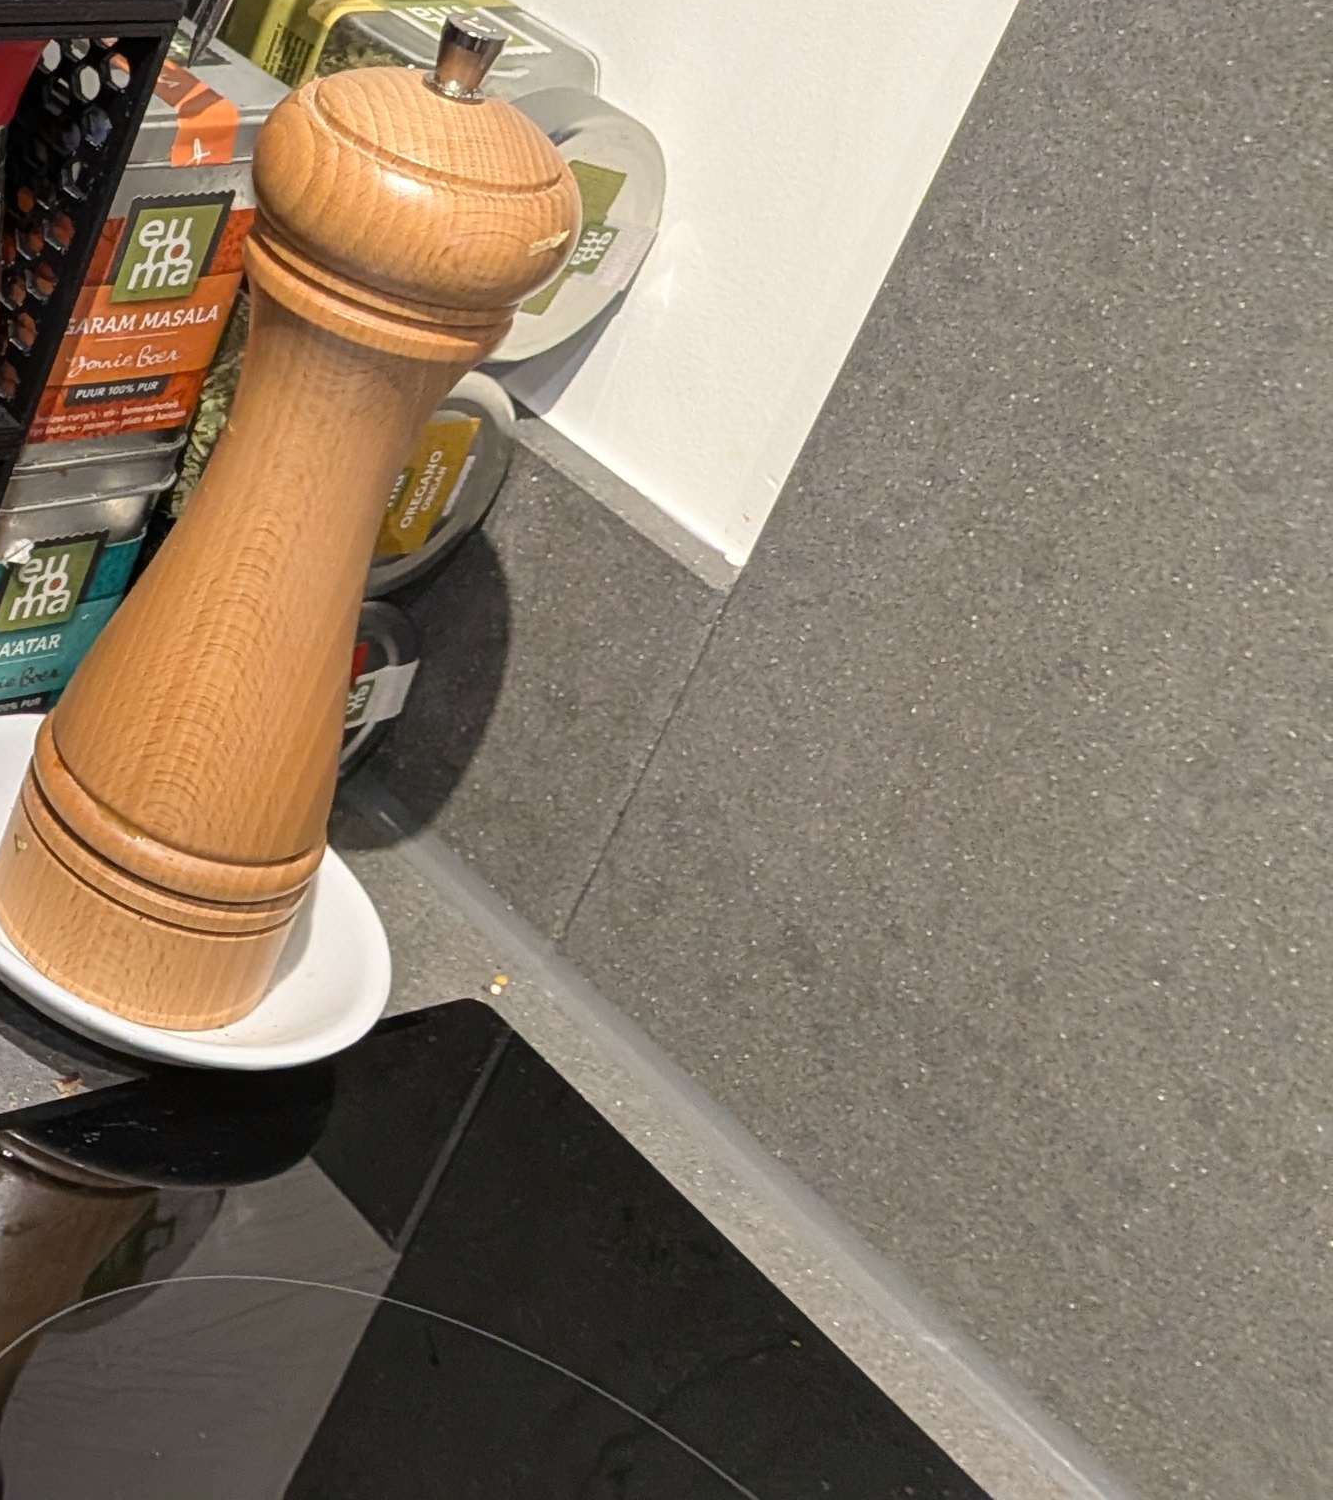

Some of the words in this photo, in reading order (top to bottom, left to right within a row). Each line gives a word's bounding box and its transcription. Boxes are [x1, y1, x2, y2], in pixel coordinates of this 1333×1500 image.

[64, 313, 138, 336] GARAM
[138, 304, 219, 331] MASALA
[74, 386, 106, 400] PUUR
[108, 383, 135, 396] 100%
[137, 380, 160, 393] PUR
[400, 450, 444, 529] OREGANO
